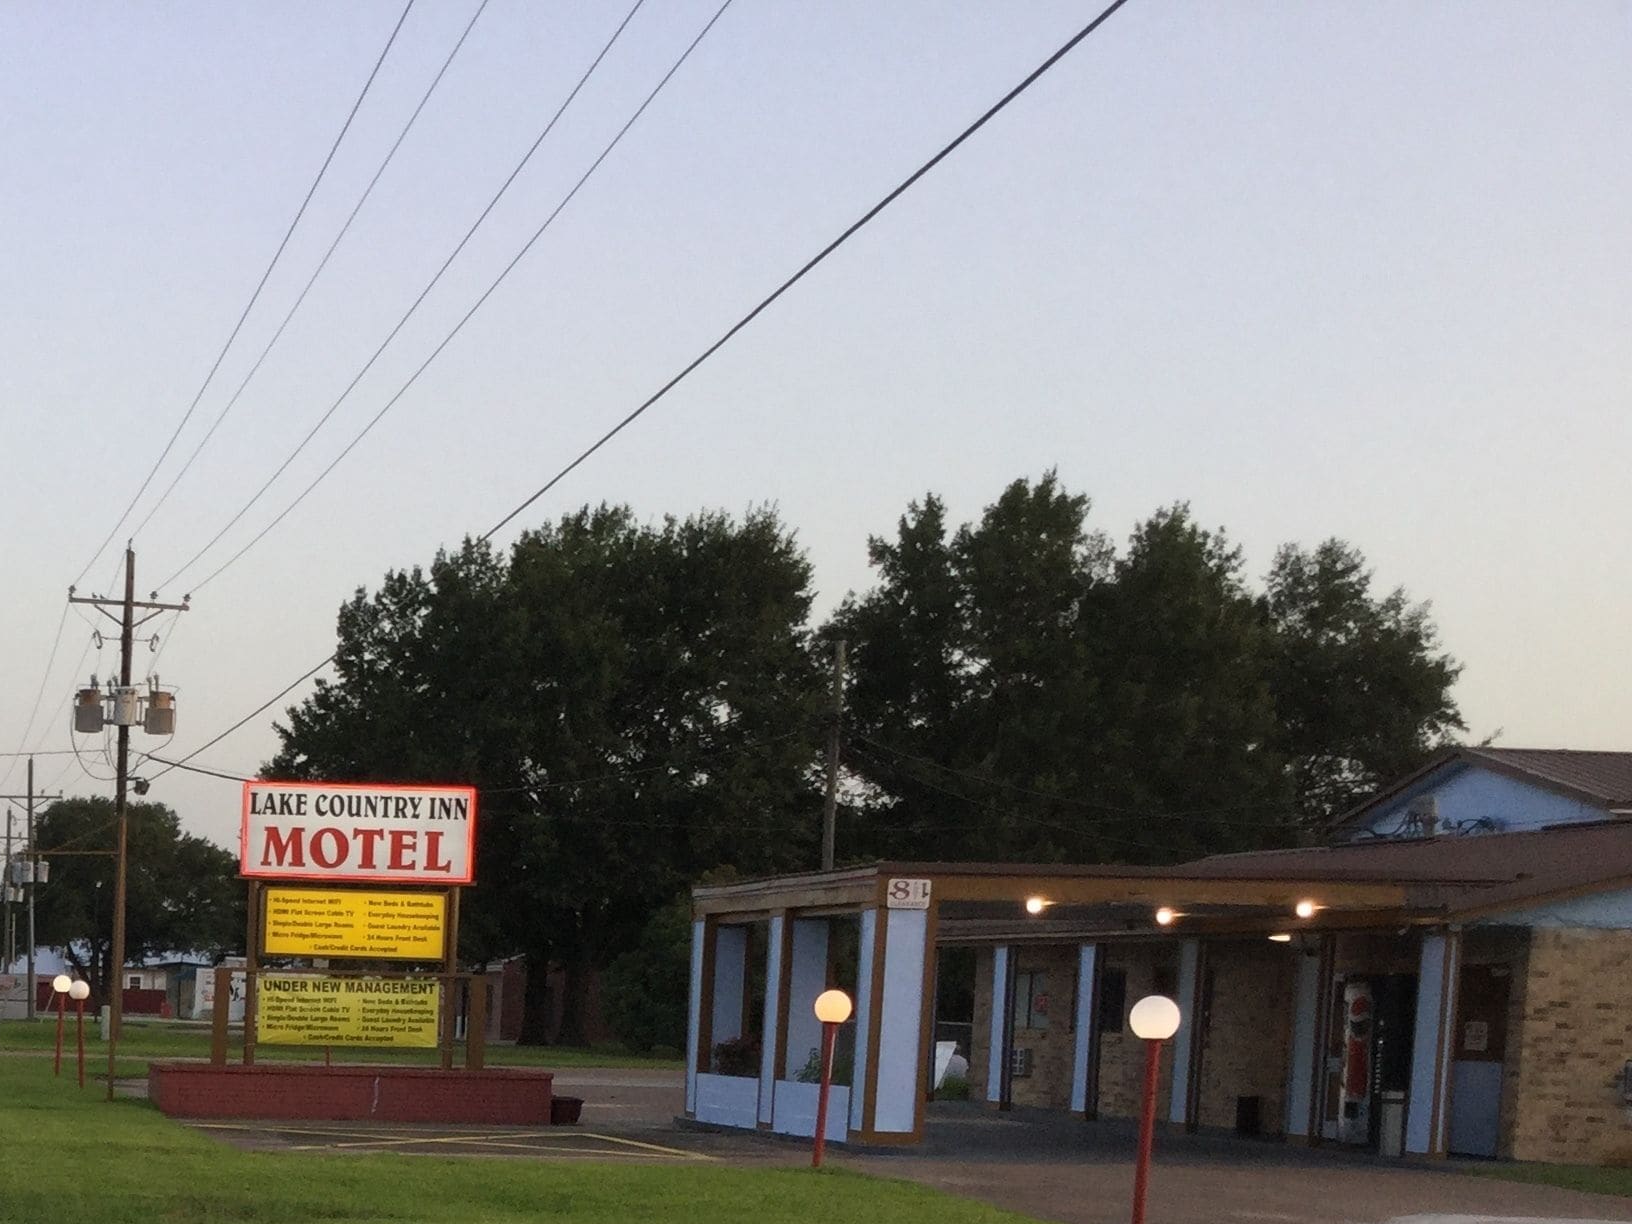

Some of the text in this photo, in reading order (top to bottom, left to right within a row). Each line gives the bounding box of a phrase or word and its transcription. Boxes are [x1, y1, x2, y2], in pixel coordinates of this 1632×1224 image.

[250, 792, 468, 820] LAKE COUNTRY INN
[260, 826, 451, 873] MOTEL
[397, 912, 439, 920] Housekeeping
[264, 980, 435, 994] UNDER NEW MANAGEMENT
[362, 1007, 389, 1015] Everyday
